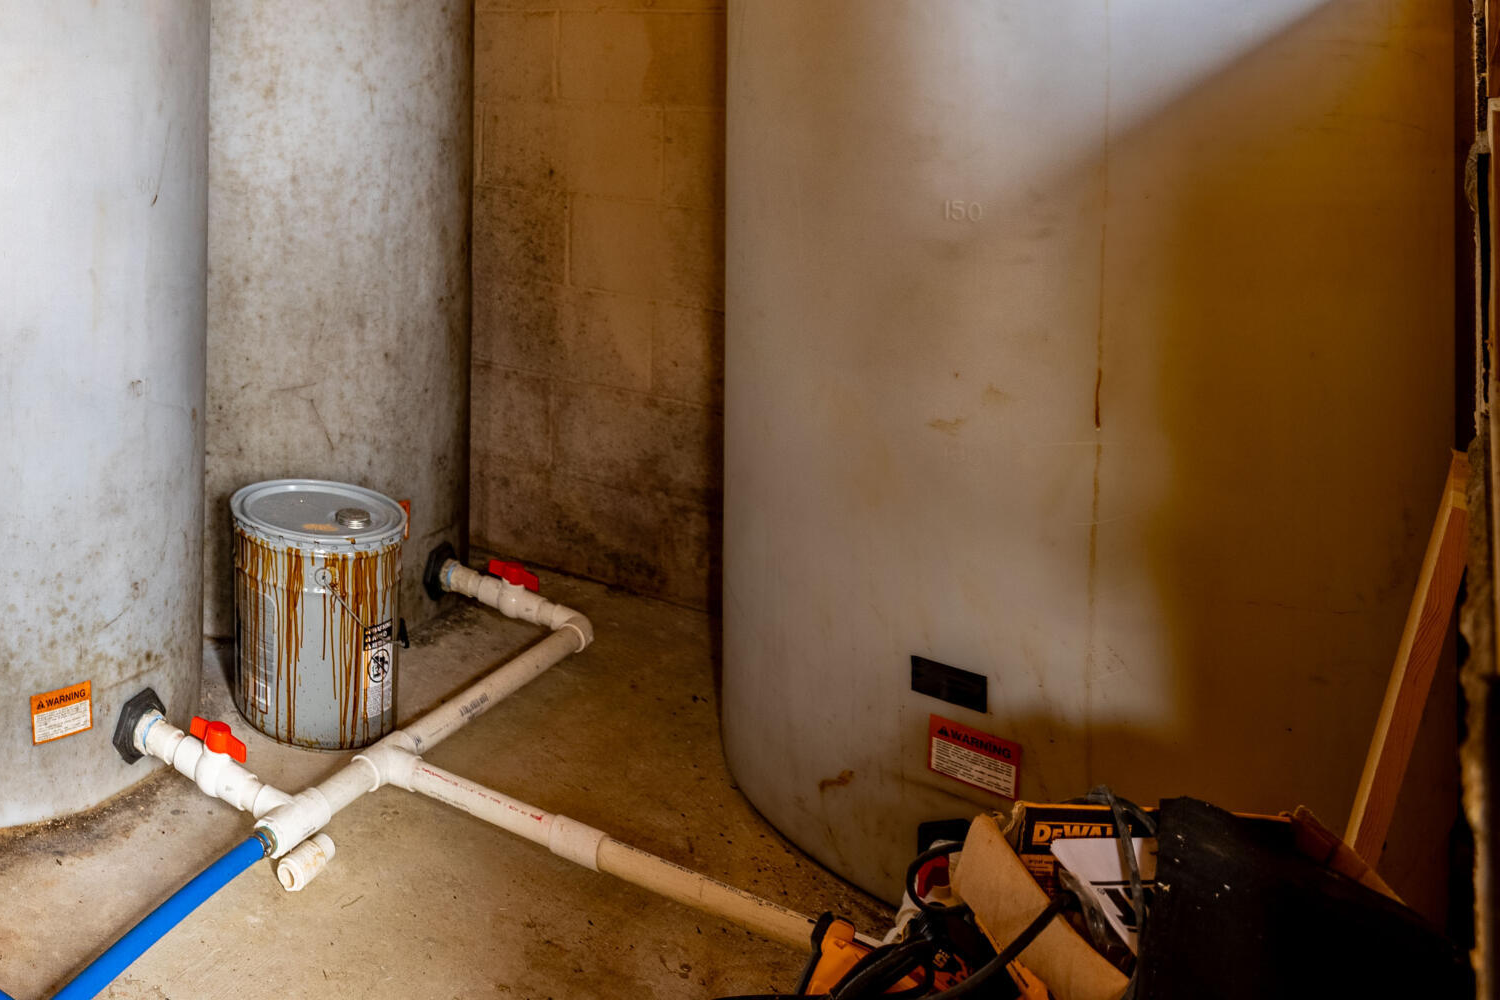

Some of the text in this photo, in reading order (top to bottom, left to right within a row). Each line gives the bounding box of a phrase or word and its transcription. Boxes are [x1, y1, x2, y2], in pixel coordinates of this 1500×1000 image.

[942, 200, 985, 224] 150
[45, 688, 86, 708] WARNING
[950, 728, 1012, 760] WARNING
